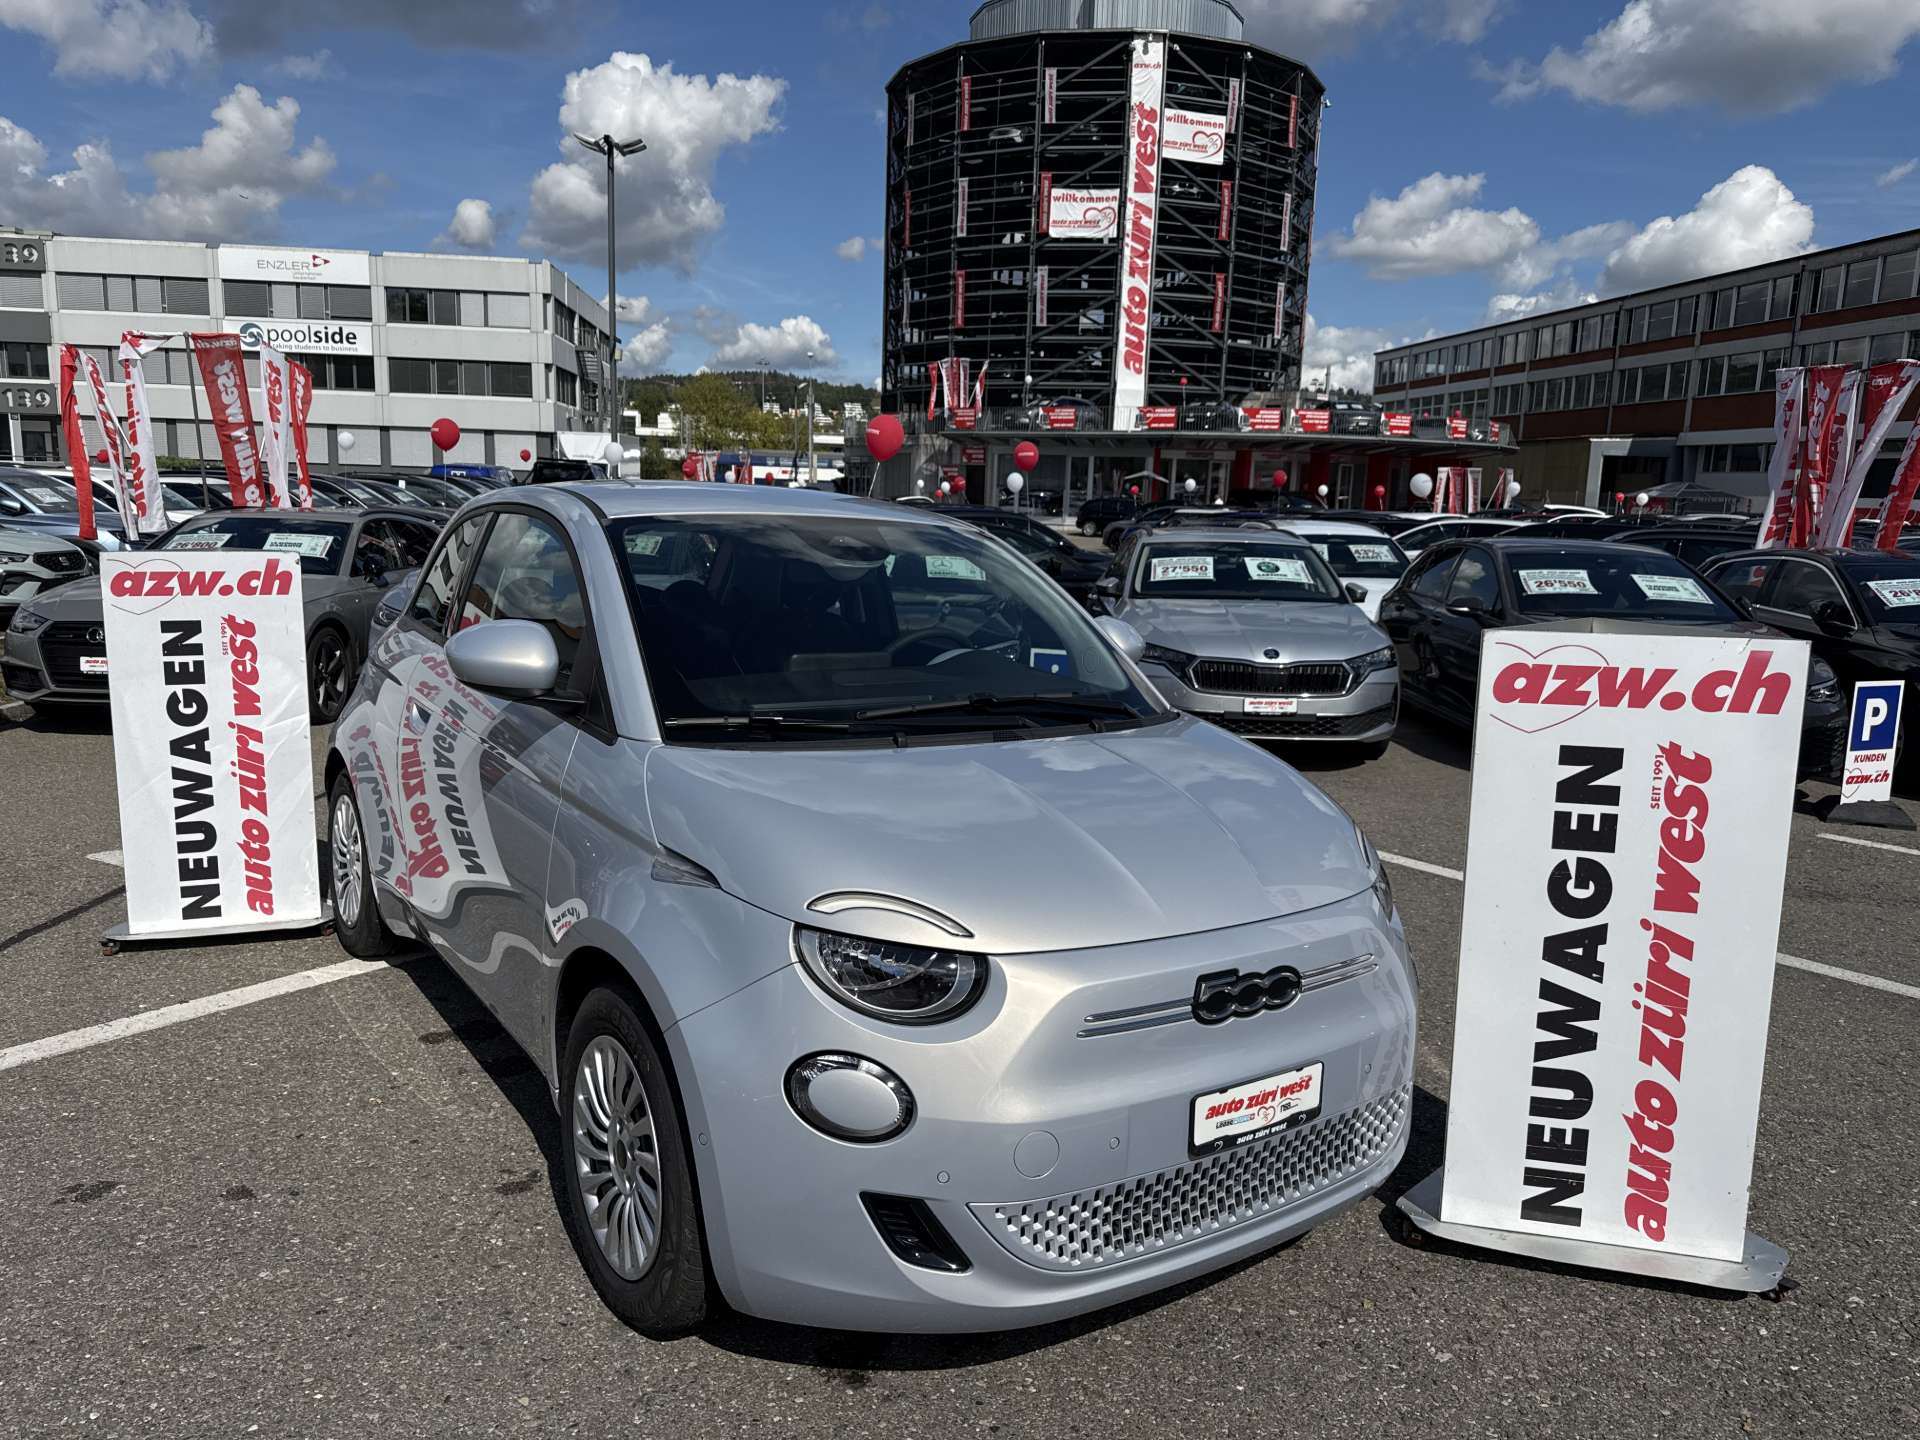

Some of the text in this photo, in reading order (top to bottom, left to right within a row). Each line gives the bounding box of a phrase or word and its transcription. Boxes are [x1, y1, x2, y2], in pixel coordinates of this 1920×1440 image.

[1165, 113, 1224, 130] willkommen
[1052, 193, 1118, 204] willkommen
[1122, 101, 1159, 376] auto züri west
[257, 259, 311, 271] ENZLER
[267, 325, 357, 346] poolside
[2, 388, 50, 408] 139
[265, 359, 283, 424] west
[110, 558, 293, 597] azw.ch
[1161, 564, 1208, 574] 27'550
[1534, 580, 1586, 589] 26'550
[221, 640, 229, 656] SEIT
[1492, 650, 1791, 715] azw.ch
[1861, 698, 1888, 742] P
[159, 619, 222, 920] NEUWAGEN
[221, 613, 274, 916] auto züri west
[1845, 769, 1890, 785] azw.ch
[1854, 753, 1887, 763] KUNDEN
[1650, 753, 1664, 810] SEIT 1991
[1192, 966, 1302, 1026] 500
[1520, 744, 1625, 1227] NEUWAGEN
[1621, 740, 1713, 1243] auto züri west
[1205, 1097, 1245, 1120] auto
[1245, 1085, 1279, 1110] züri
[1279, 1075, 1313, 1099] west
[1236, 1122, 1288, 1145] auto züri west
